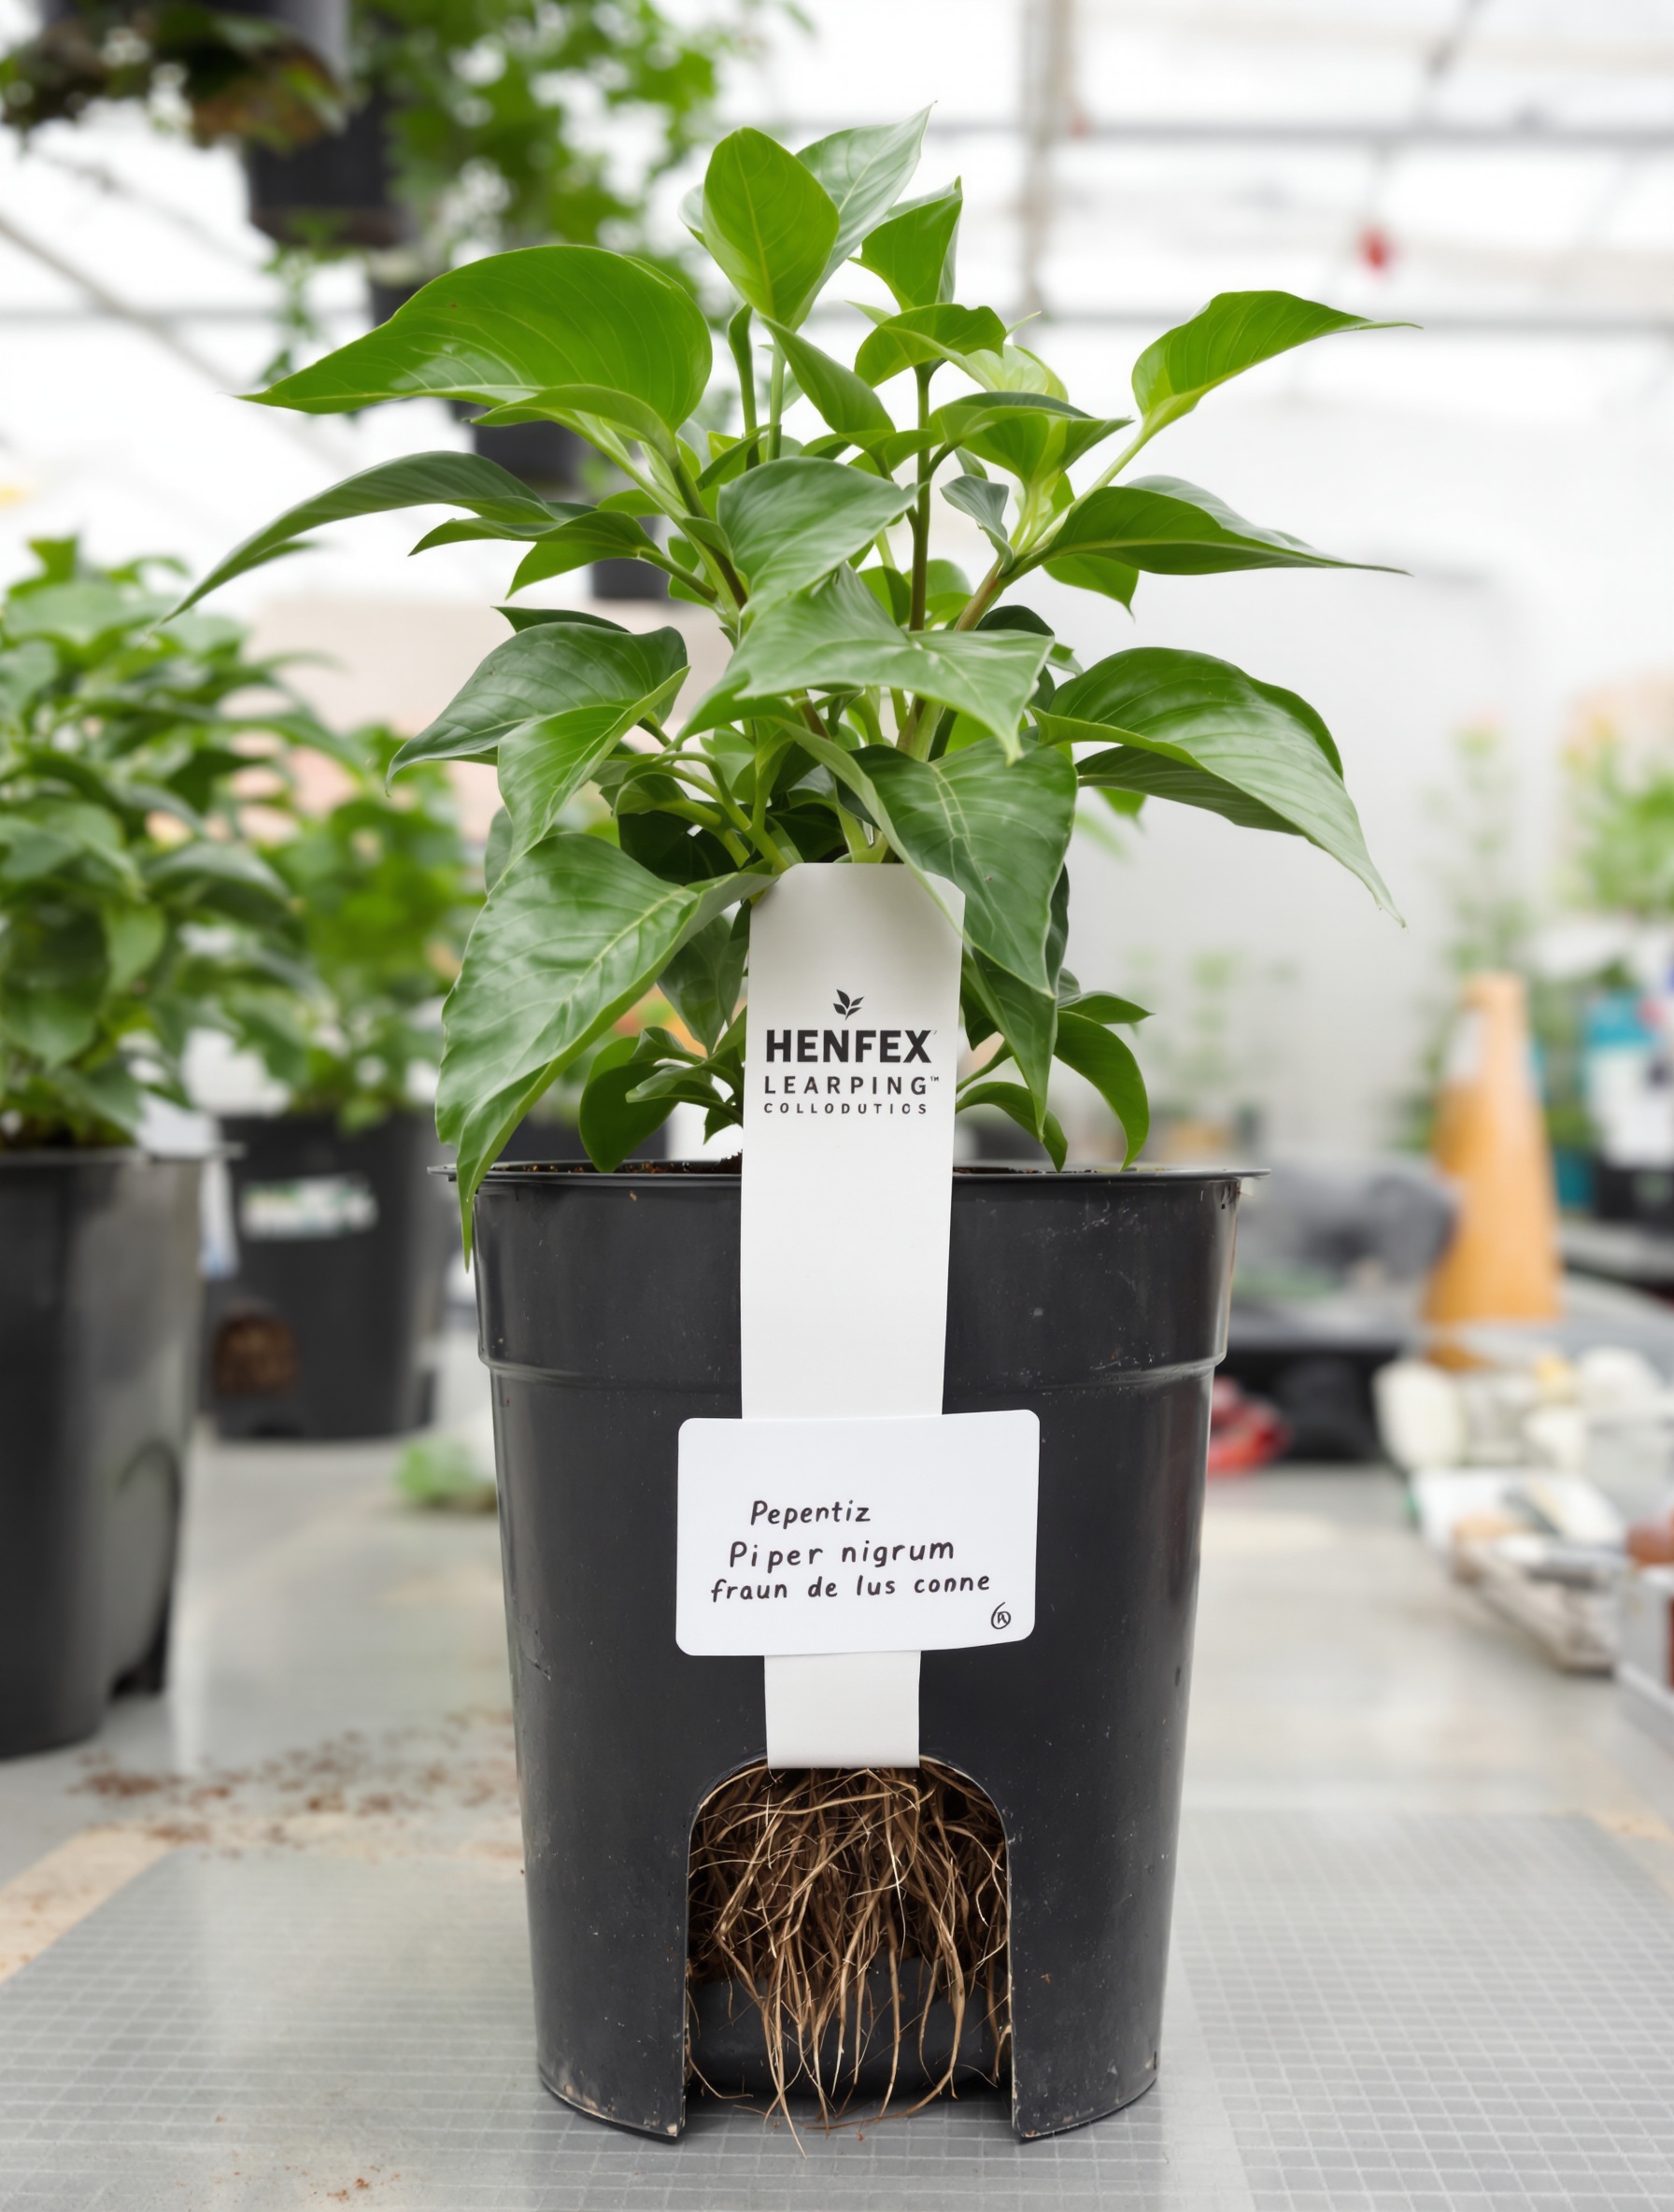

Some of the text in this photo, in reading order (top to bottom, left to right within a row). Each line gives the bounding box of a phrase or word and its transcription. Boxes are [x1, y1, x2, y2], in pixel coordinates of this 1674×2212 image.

[766, 1028, 932, 1064] HENFEX
[750, 1499, 871, 1529] Pepentiz
[730, 1539, 954, 1573] Piper nigrum
[711, 1574, 990, 1603] fraun de lus conne
